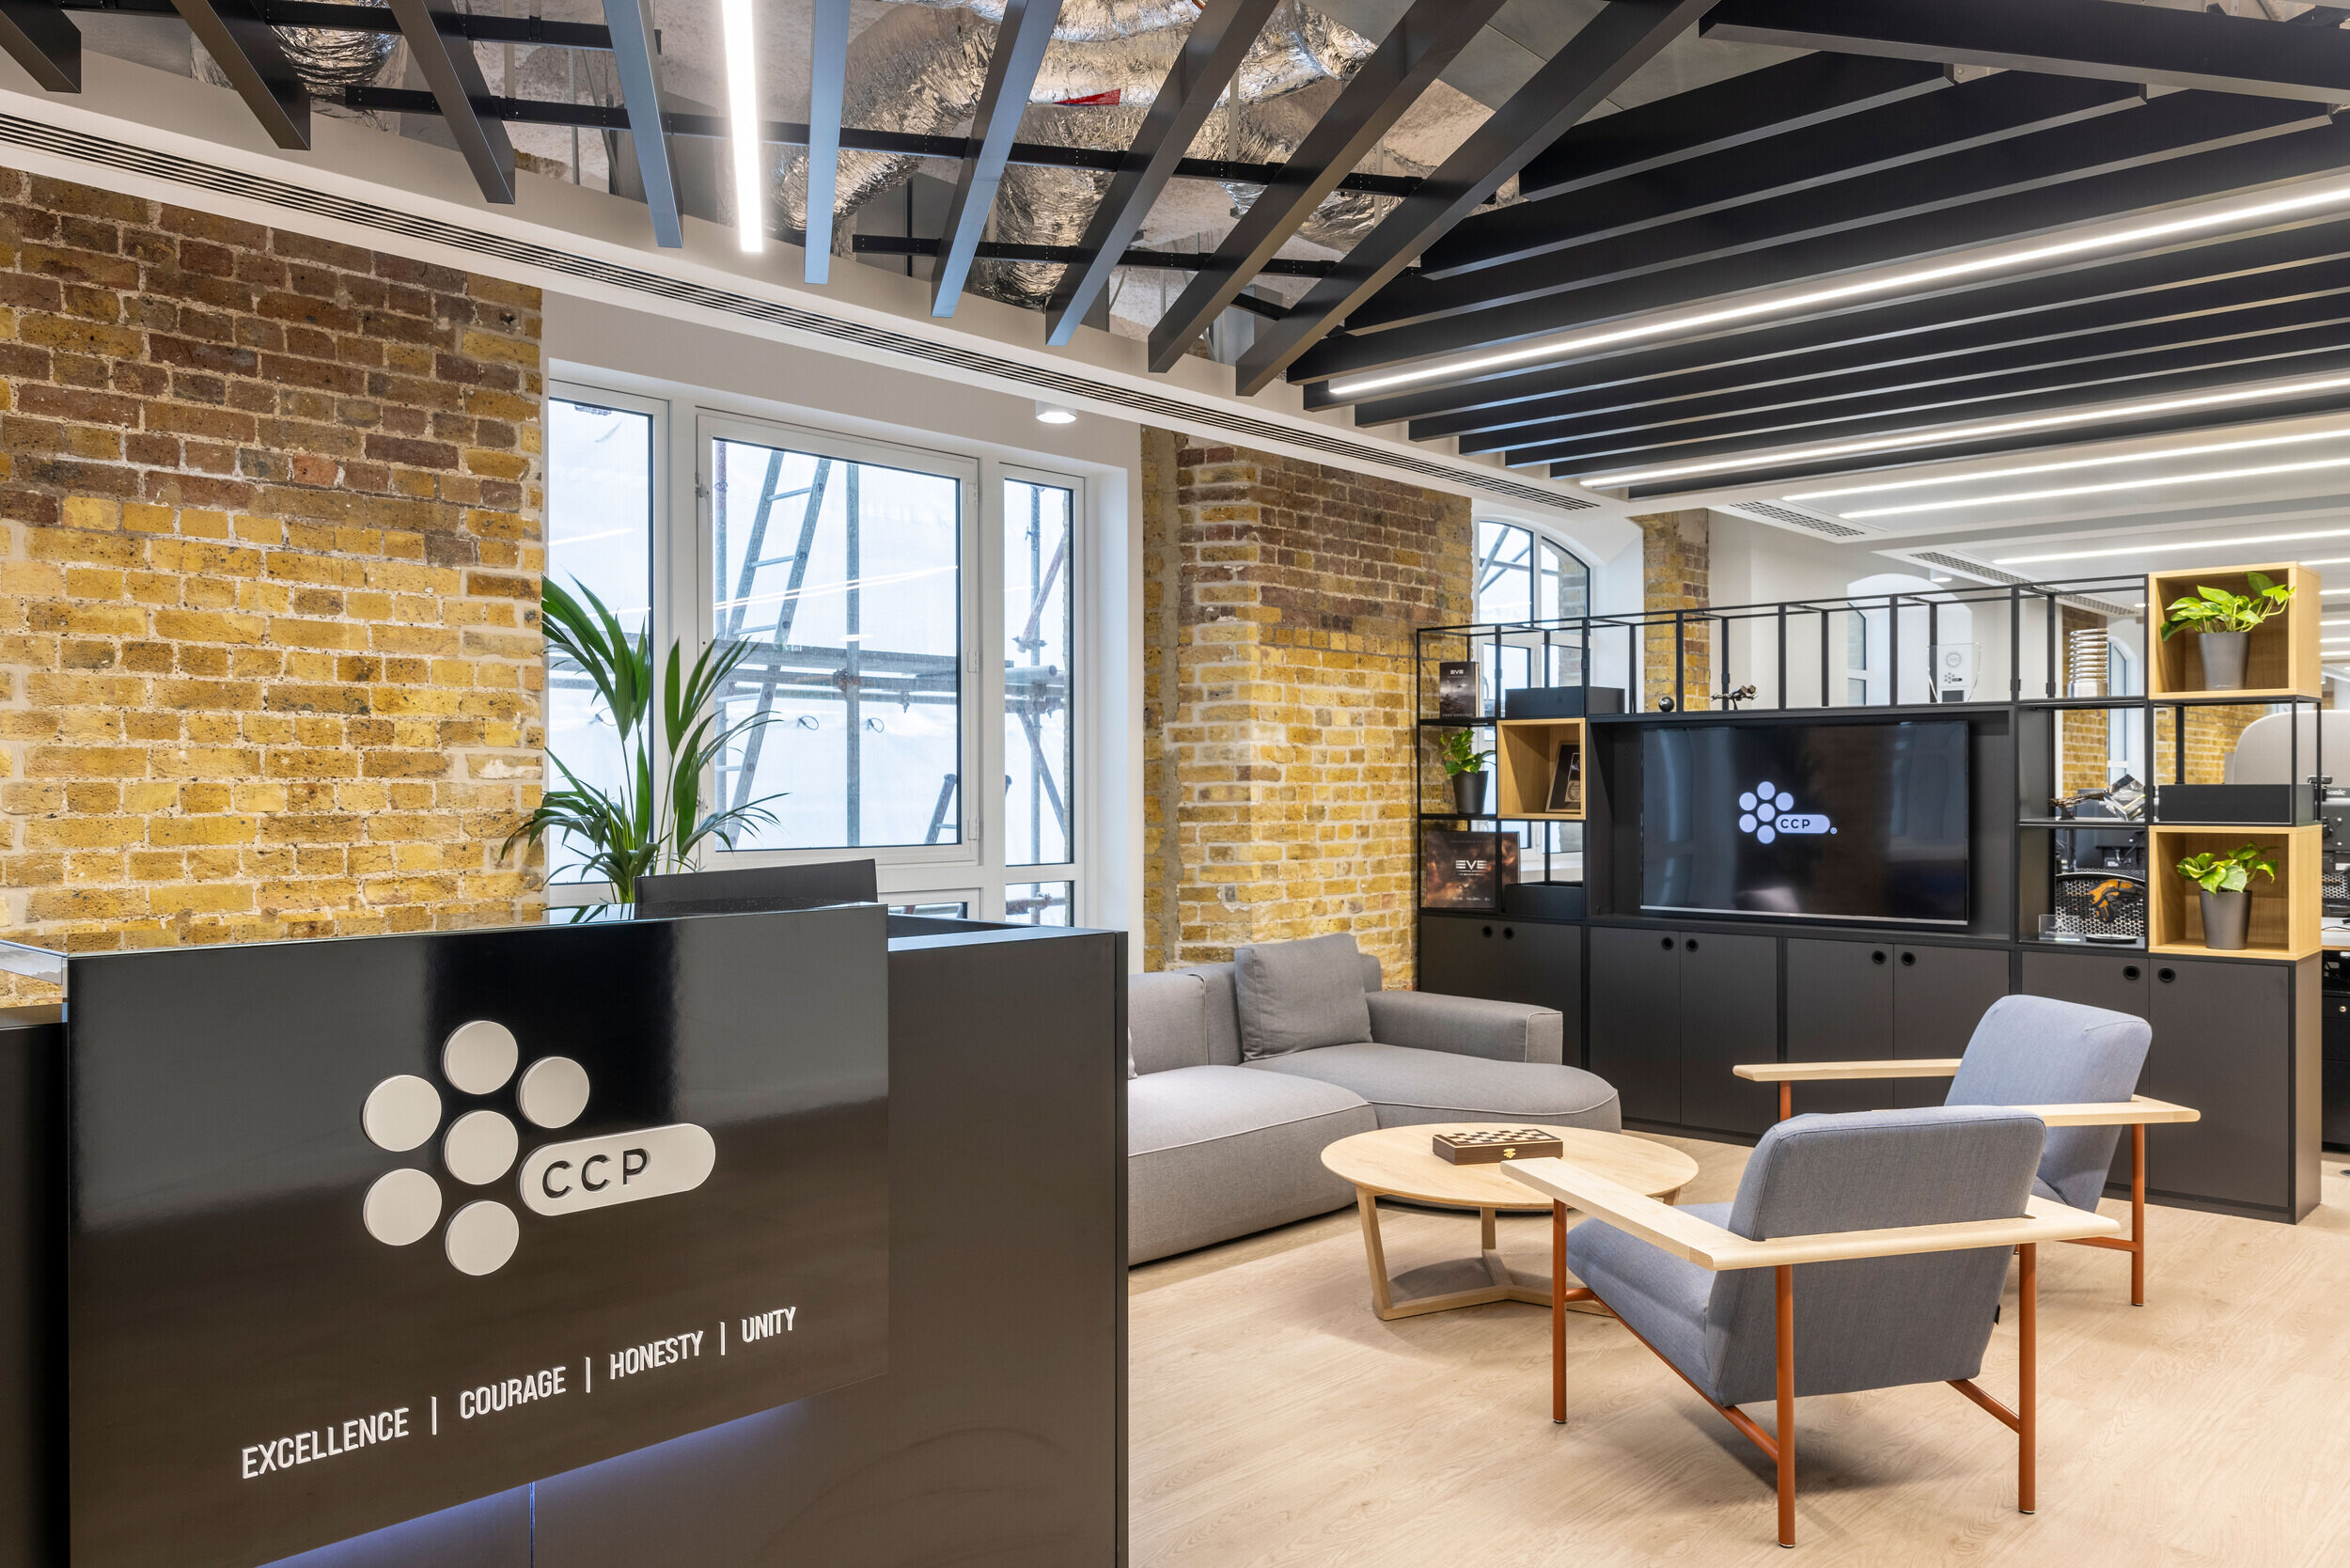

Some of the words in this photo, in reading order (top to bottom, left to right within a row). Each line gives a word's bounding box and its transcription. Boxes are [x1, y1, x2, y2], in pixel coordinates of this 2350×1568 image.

[1780, 819, 1810, 829] CCP
[1456, 860, 1487, 870] EVE
[542, 1148, 650, 1199] CCP
[242, 1407, 409, 1479] EXCELLENCE
[460, 1366, 567, 1419] COURAGE
[609, 1330, 704, 1380] HONESTY
[741, 1307, 796, 1343] UNITY
